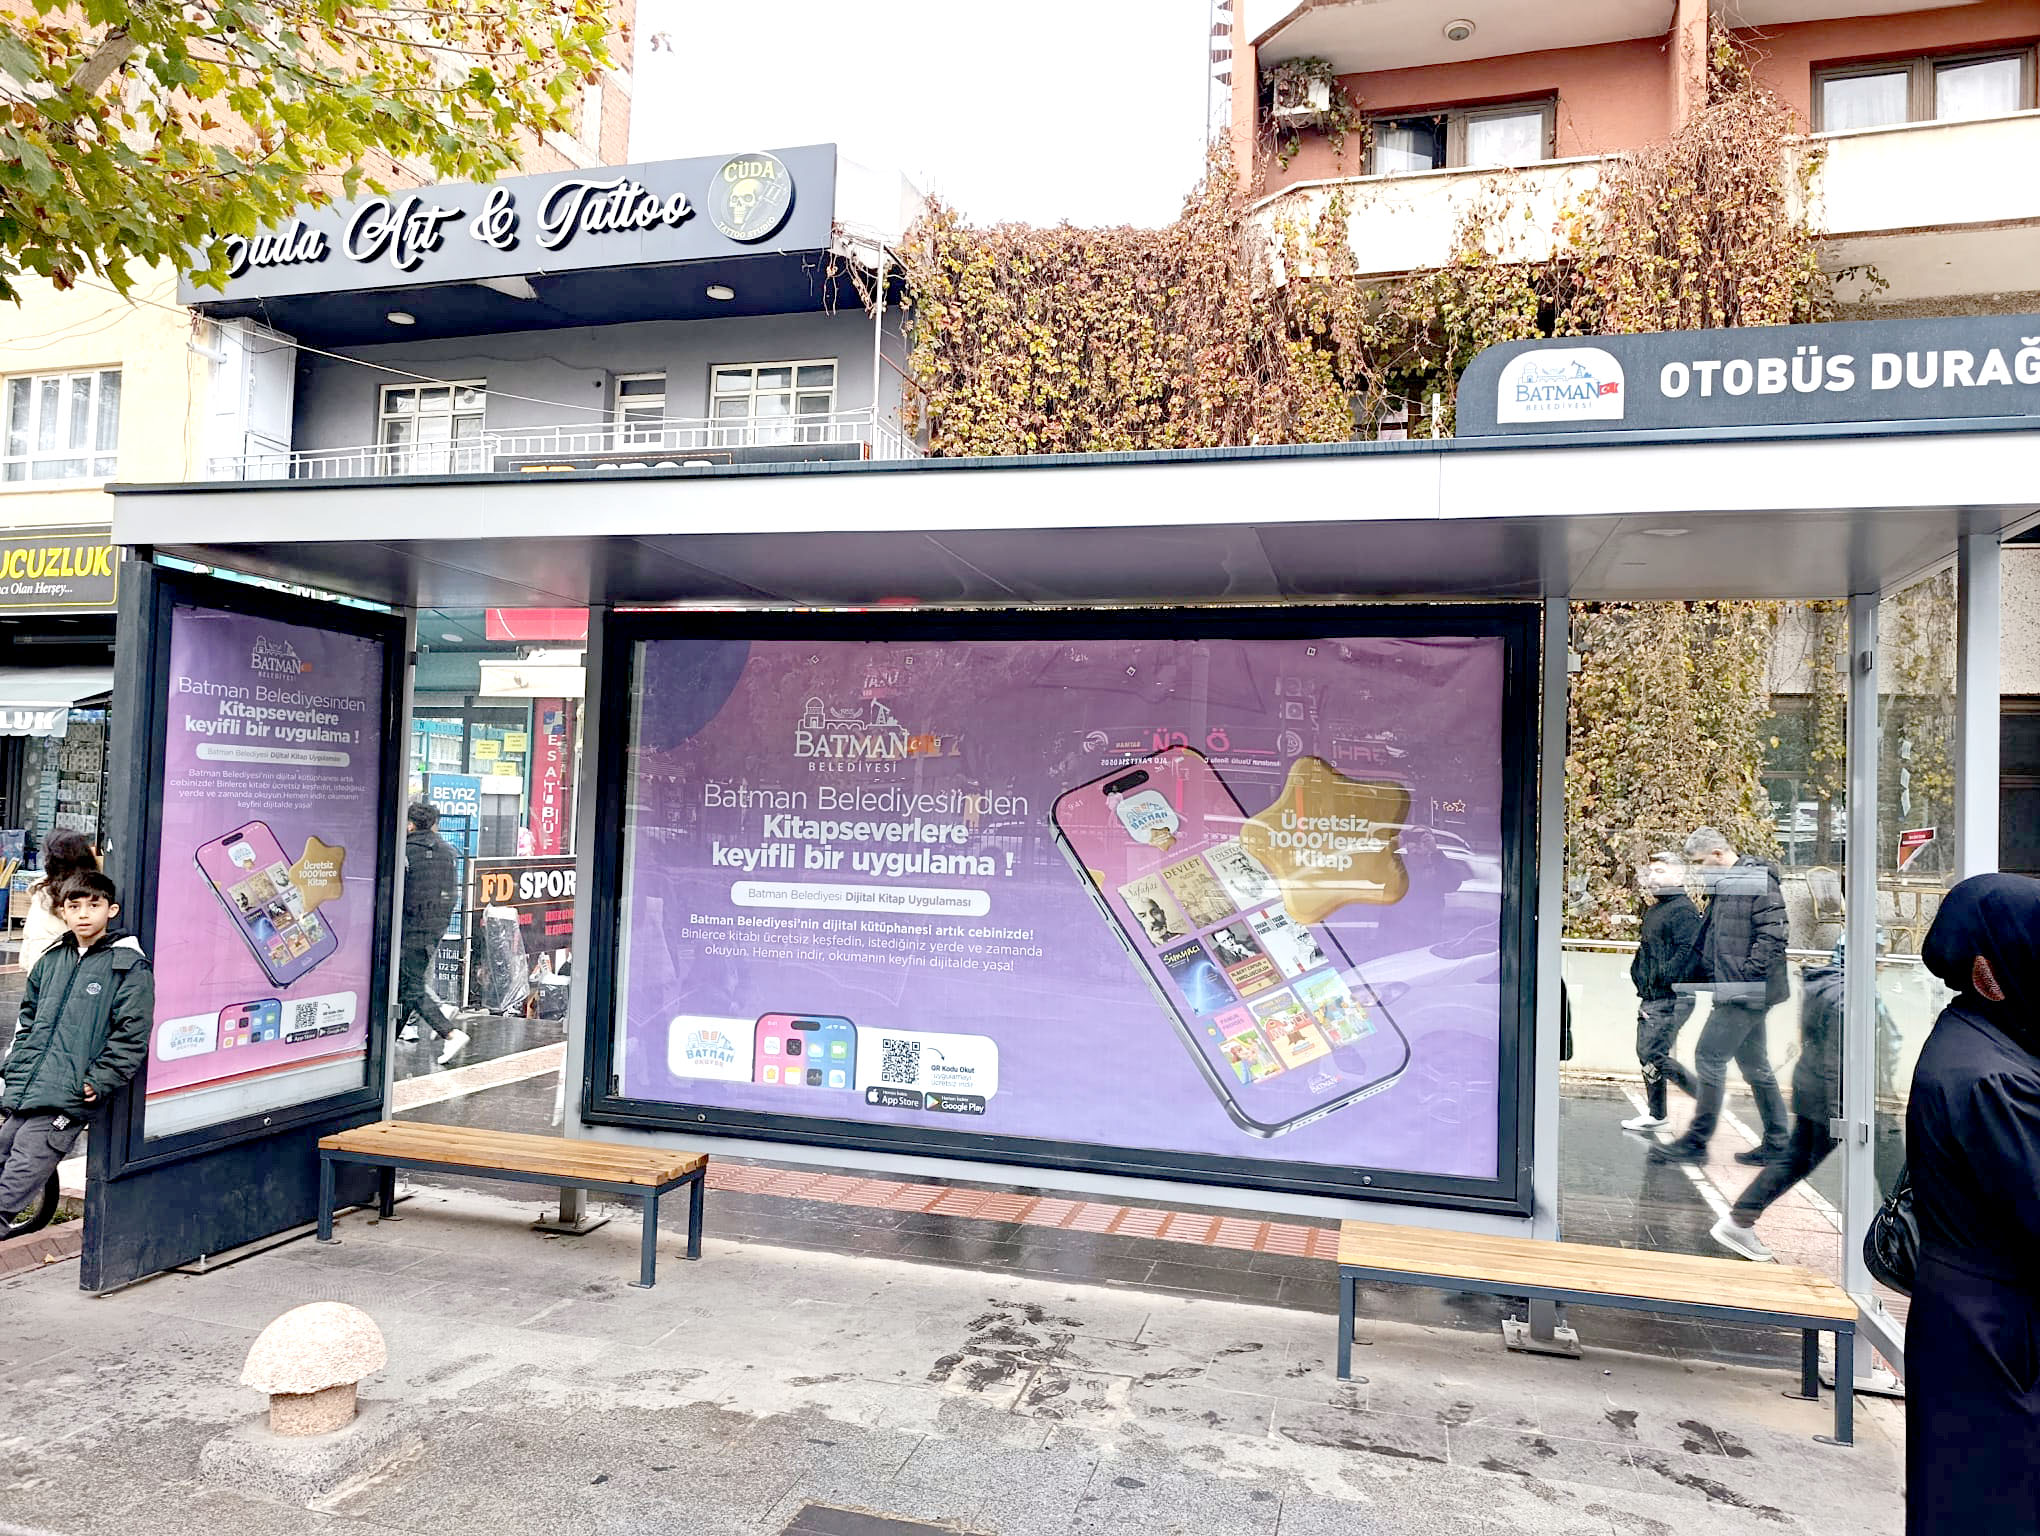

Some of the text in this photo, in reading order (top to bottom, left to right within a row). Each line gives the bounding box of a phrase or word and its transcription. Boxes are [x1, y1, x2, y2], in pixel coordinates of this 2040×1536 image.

[204, 176, 691, 276] uda Art & Tattoo
[718, 216, 776, 239] TATTOO STUDIO
[1659, 336, 2040, 398] OTOBÜS DURAĞ
[1515, 381, 1601, 402] BATMAN
[1526, 401, 1592, 411] BELEDİYESİ
[11, 582, 33, 595] Olan
[251, 653, 301, 675] BATMAN
[178, 676, 365, 712] Batman Belediyesinden
[219, 700, 339, 725] Kitapseverlere
[185, 714, 360, 744] keyifli bir uygulama !
[794, 729, 911, 760] BATMAN
[808, 760, 897, 773] BELEDİYESİ
[433, 786, 476, 801] BEYAZ
[703, 783, 1029, 817] Batman Belediyesinden
[763, 814, 969, 844] Kitapseverlere
[1281, 808, 1369, 833] Ücretsiz
[1268, 830, 1381, 852] 1000'lerce
[303, 860, 334, 870] Ücretsiz
[711, 841, 1014, 877] keyifli bir uygulama !
[1210, 846, 1243, 861] TOLSTO
[1295, 849, 1353, 872] Kitap
[1163, 858, 1202, 880] DEVLET
[307, 878, 328, 888] Kitap
[480, 870, 576, 903] FD SPOR
[748, 887, 972, 909] Batman Belediyesi Dijital Kitap Uygulaması
[690, 914, 1034, 941] Batman Belediyesi'nin dijital kütüphanesi artık cebinizde!
[681, 927, 1043, 957] Binlerce kitabı ücretsiz keşfedin, istediğiniz yerde ve zamanda
[705, 945, 1015, 973] okuyun. Hemen indir, okumanın keyfini dijitalde yaşa!
[942, 1065, 958, 1073] Kodu
[959, 1066, 975, 1074] Okut
[882, 1096, 919, 1108] App Store
[941, 1101, 985, 1113] Google Play
